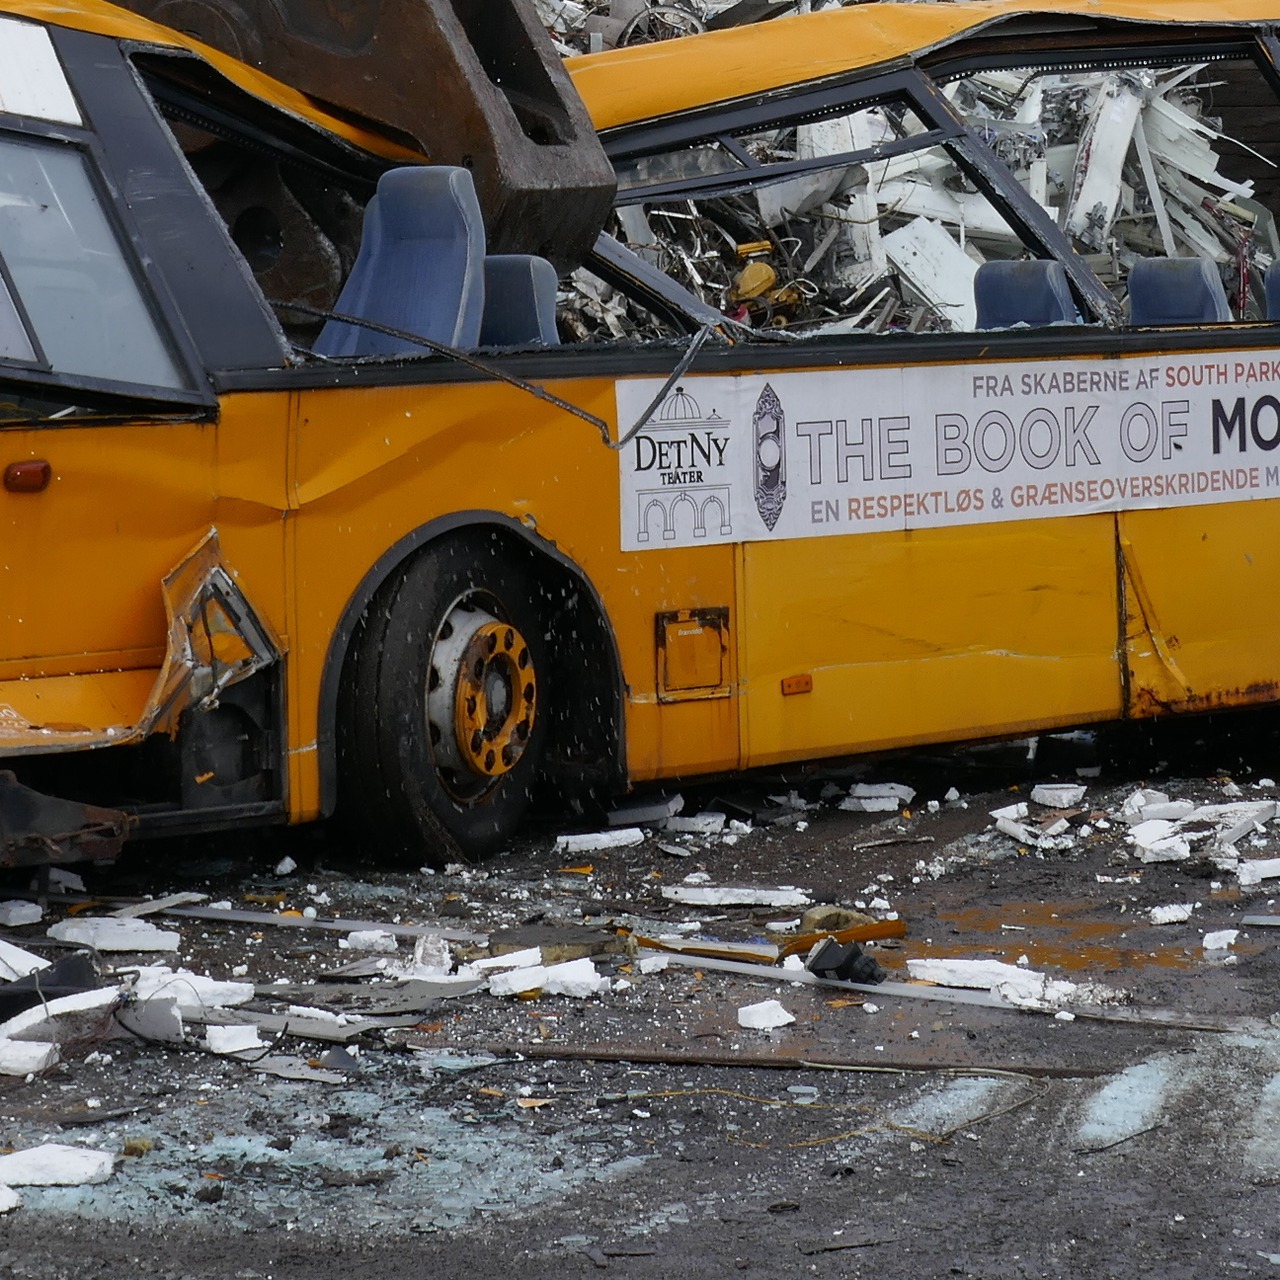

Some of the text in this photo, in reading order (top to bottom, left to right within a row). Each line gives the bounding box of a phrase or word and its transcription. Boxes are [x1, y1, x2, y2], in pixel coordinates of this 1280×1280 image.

[972, 374, 1014, 399] FRA
[1021, 370, 1129, 396] SKABERNE
[1135, 368, 1160, 391] AF
[1165, 363, 1229, 388] SOUTH
[796, 416, 912, 485] THE
[935, 405, 1101, 476] BOOK
[1119, 400, 1190, 464] OF
[660, 470, 704, 486] TEATER
[811, 499, 840, 524] EN
[847, 487, 985, 520] RESPEKTLØS
[991, 487, 1004, 509] &
[1010, 467, 1260, 508] GRÆNSEOVERSKRIDENDE
